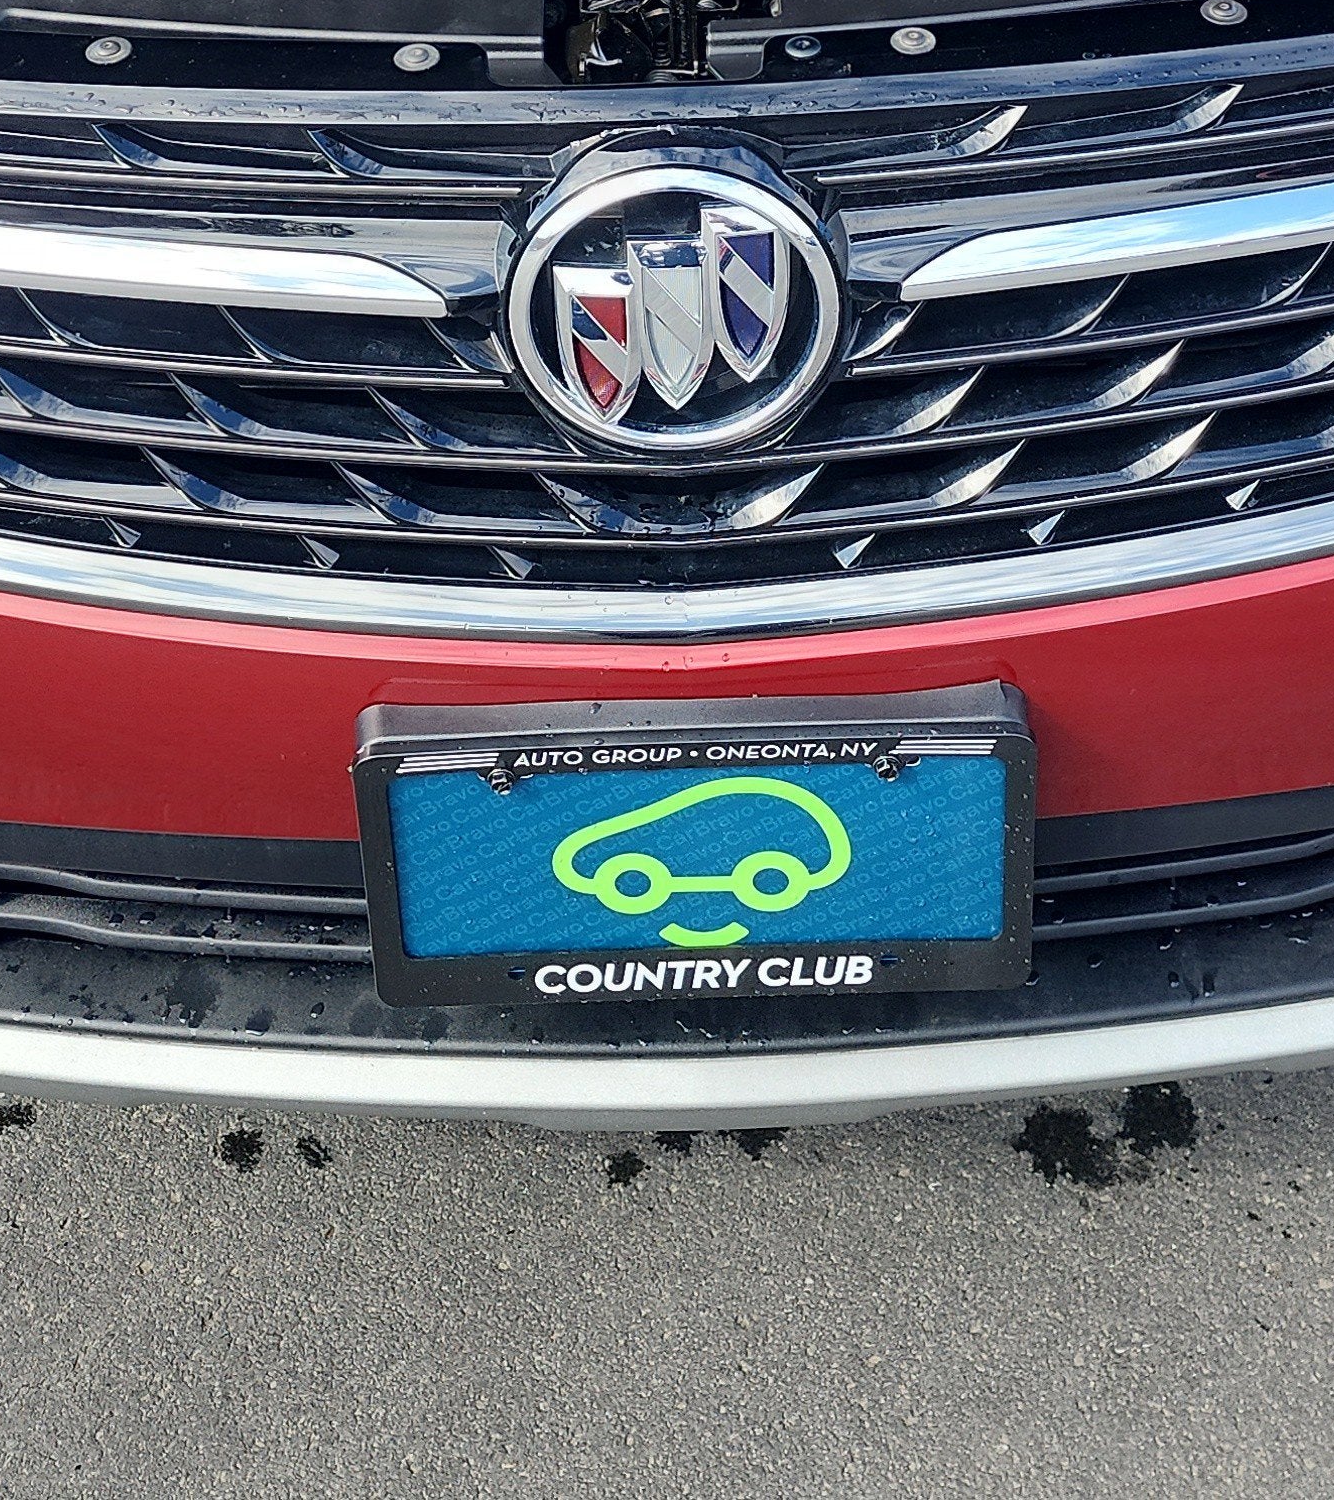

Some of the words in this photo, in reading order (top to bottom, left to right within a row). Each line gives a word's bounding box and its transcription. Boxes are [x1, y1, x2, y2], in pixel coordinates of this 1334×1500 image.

[514, 750, 583, 768] AUTO
[592, 747, 682, 765] GROUP
[399, 853, 478, 896] arBravo
[534, 958, 752, 994] COUNTRY
[757, 955, 873, 987] CLUB
